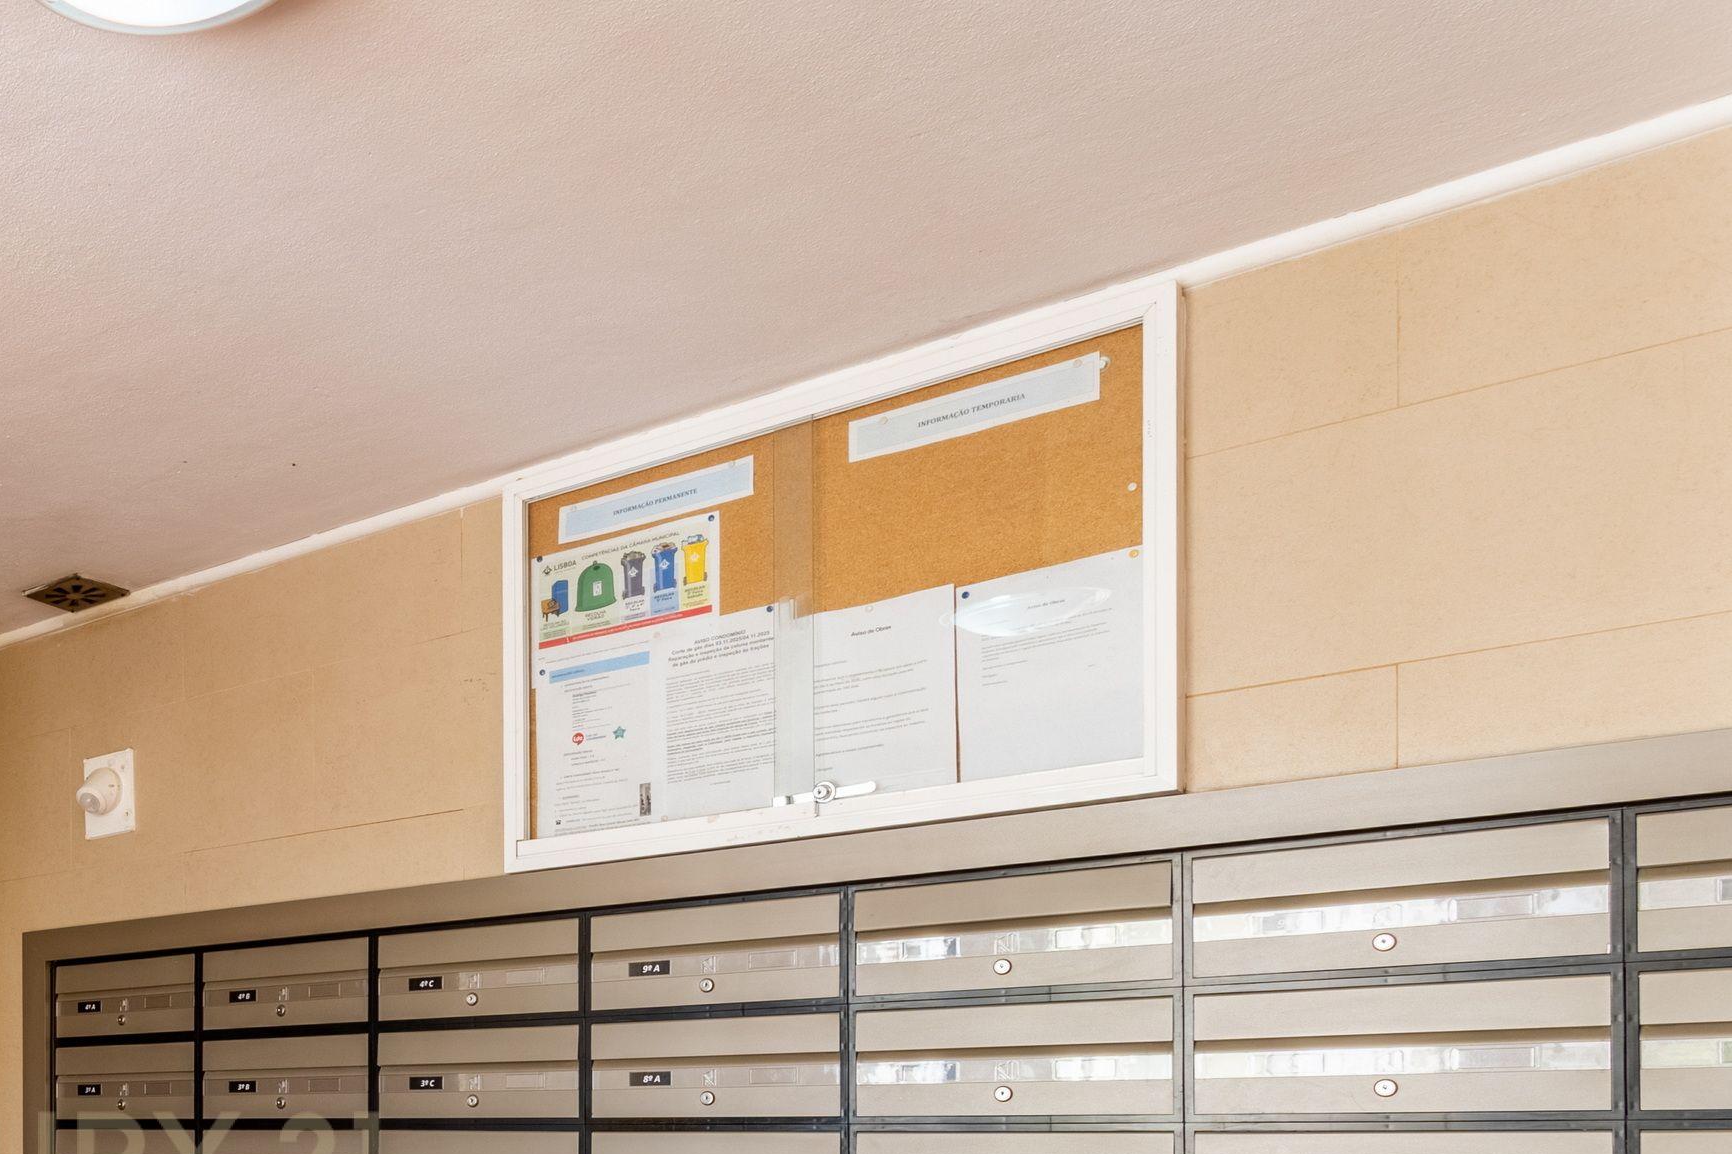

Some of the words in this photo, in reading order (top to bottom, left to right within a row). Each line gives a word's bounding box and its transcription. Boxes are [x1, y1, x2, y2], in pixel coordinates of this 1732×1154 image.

[918, 408, 969, 428] INFORMAÇÃO
[613, 500, 653, 516] INFORMAÇÃO
[654, 488, 697, 505] PERMANENTE
[553, 560, 577, 571] LISBOA
[642, 964, 653, 973] 9º
[653, 964, 660, 972] A
[419, 980, 428, 988] 4º
[643, 1075, 653, 1083] 8º
[654, 1075, 661, 1083] A
